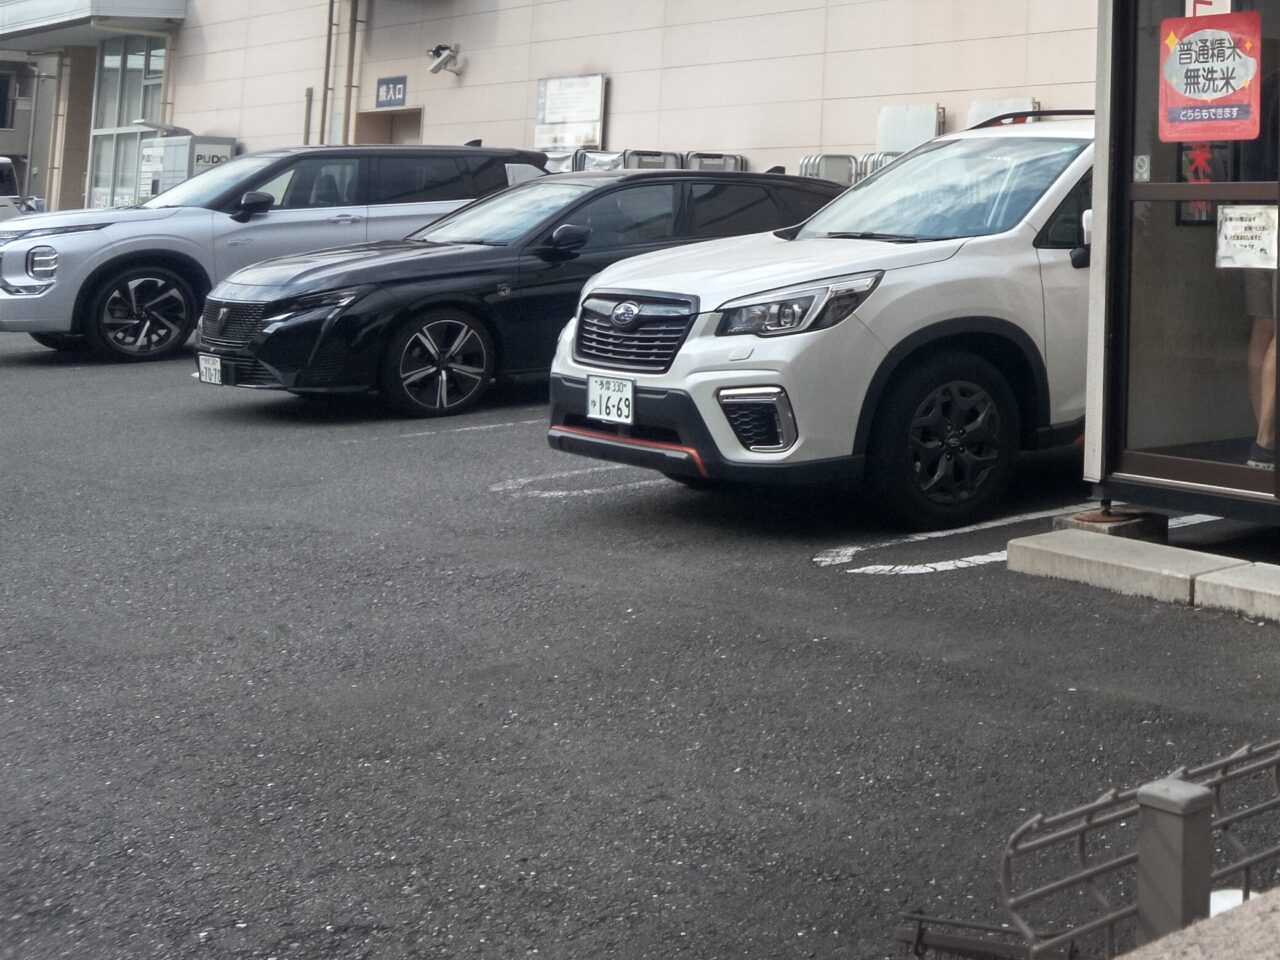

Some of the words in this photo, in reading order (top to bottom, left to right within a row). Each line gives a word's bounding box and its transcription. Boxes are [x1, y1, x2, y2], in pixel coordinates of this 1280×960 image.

[1178, 38, 1242, 65] 普通精米
[1183, 66, 1236, 94] 無洗米
[1180, 107, 1239, 120] どちらもできます
[196, 154, 229, 164] PUDO
[599, 394, 631, 419] 16-69
